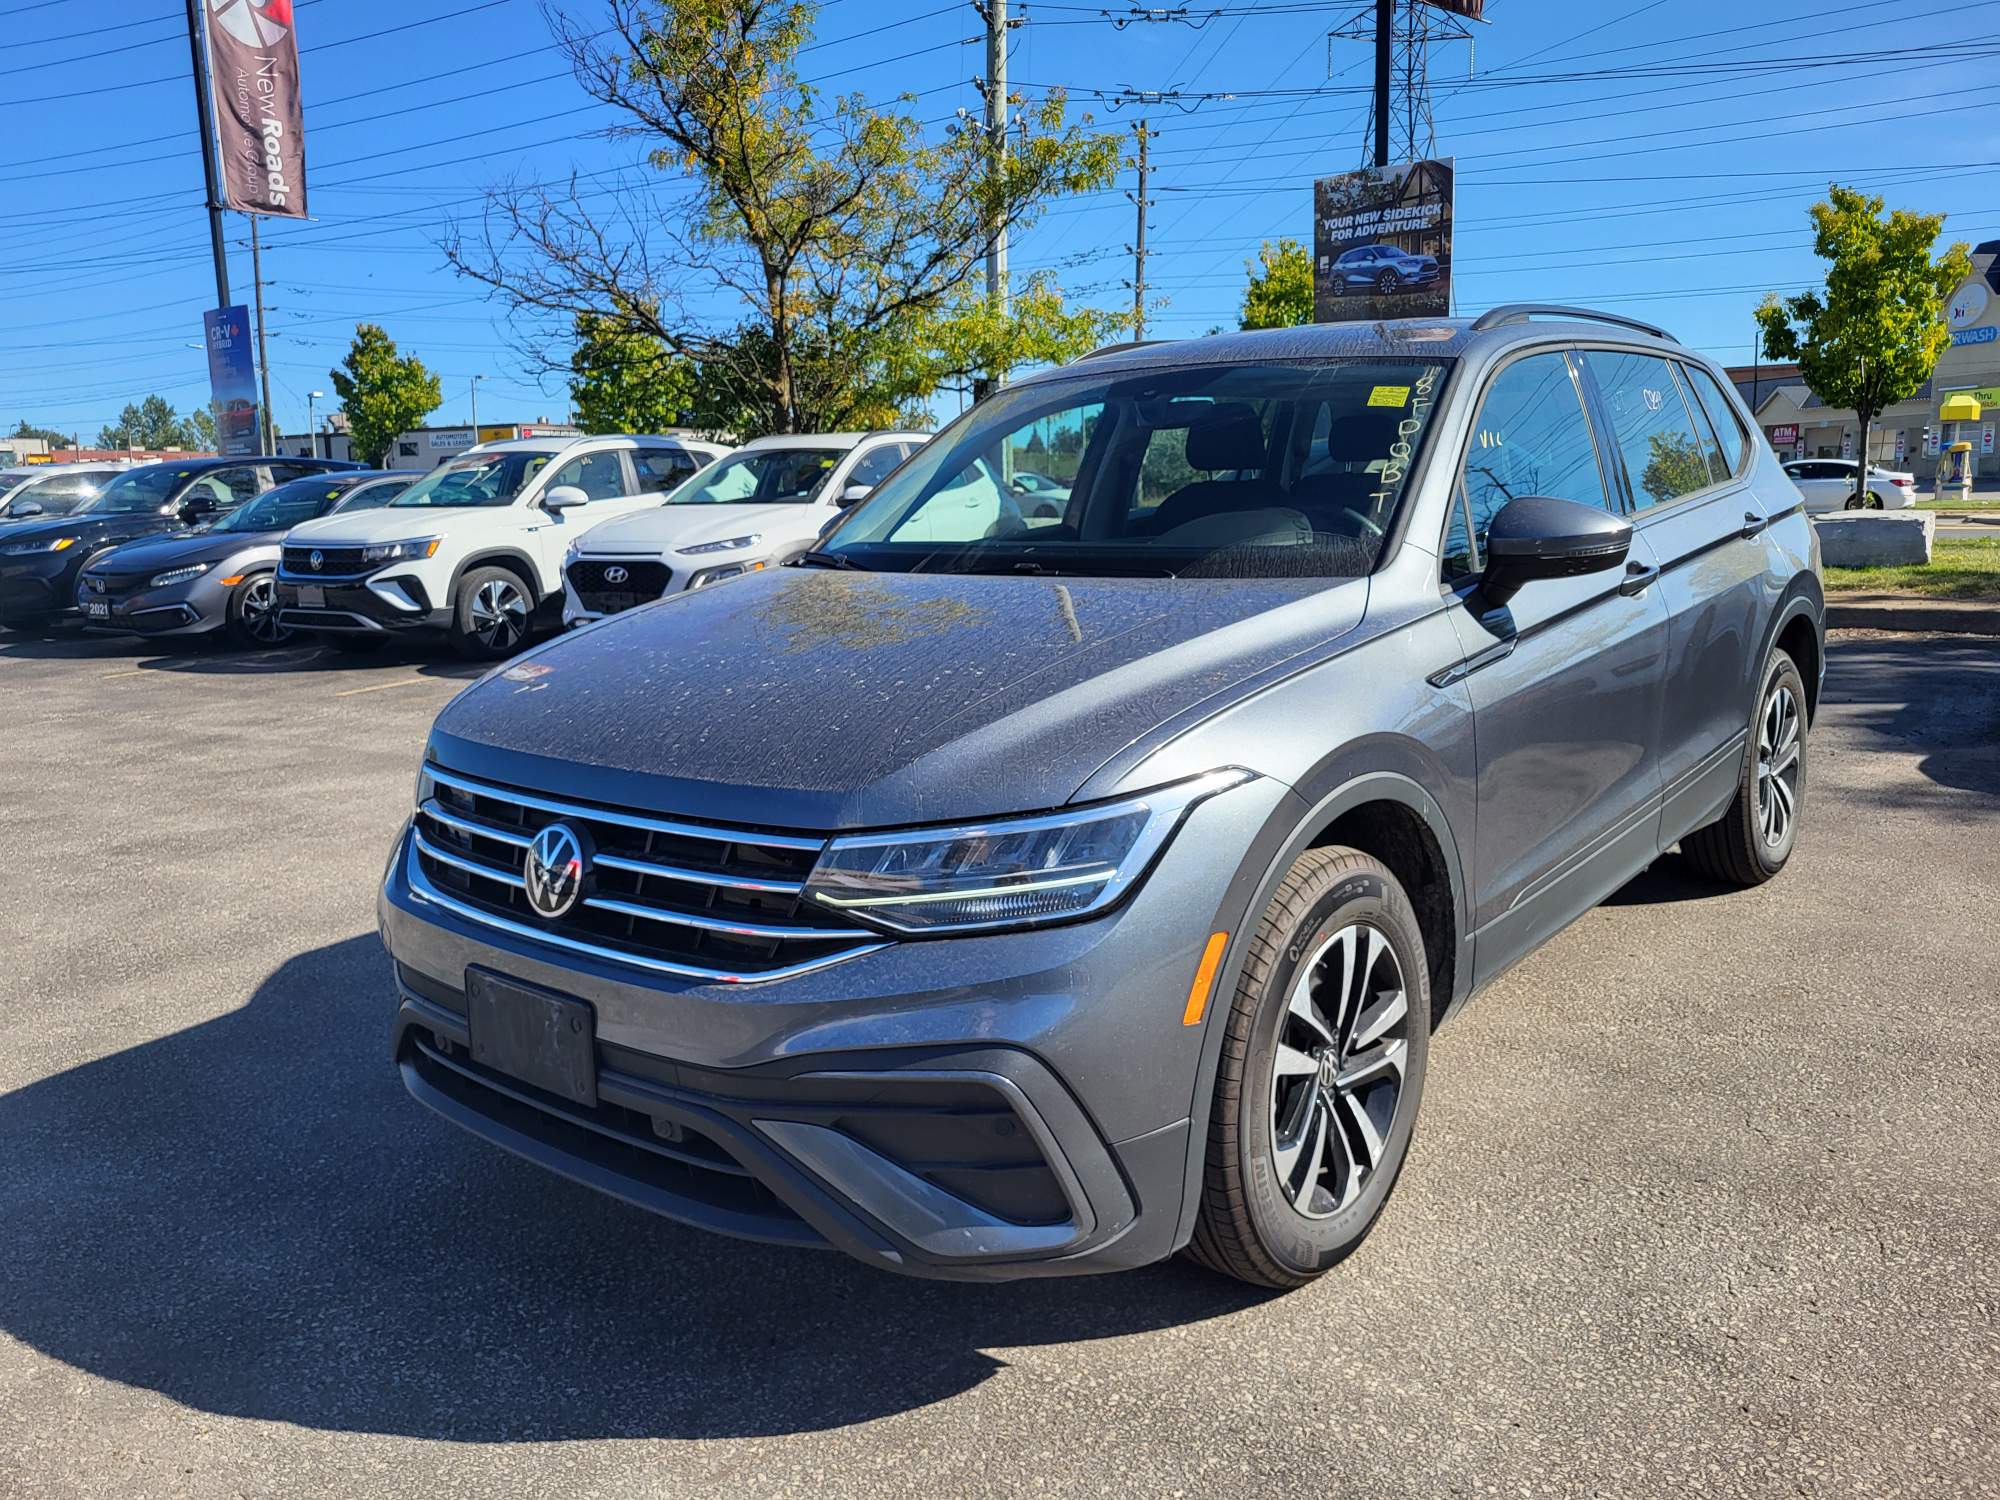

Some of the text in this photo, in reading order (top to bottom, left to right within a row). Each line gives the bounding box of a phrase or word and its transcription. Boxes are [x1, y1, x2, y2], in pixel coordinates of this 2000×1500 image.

[237, 67, 254, 148] Automove
[1323, 203, 1443, 231] YOUR NEW SIDEKICK
[1331, 229, 1353, 242] FOR
[211, 323, 231, 341] CR-V
[1974, 391, 1993, 401] Thru
[1774, 427, 1792, 437] ATM
[89, 603, 108, 615] 2021
